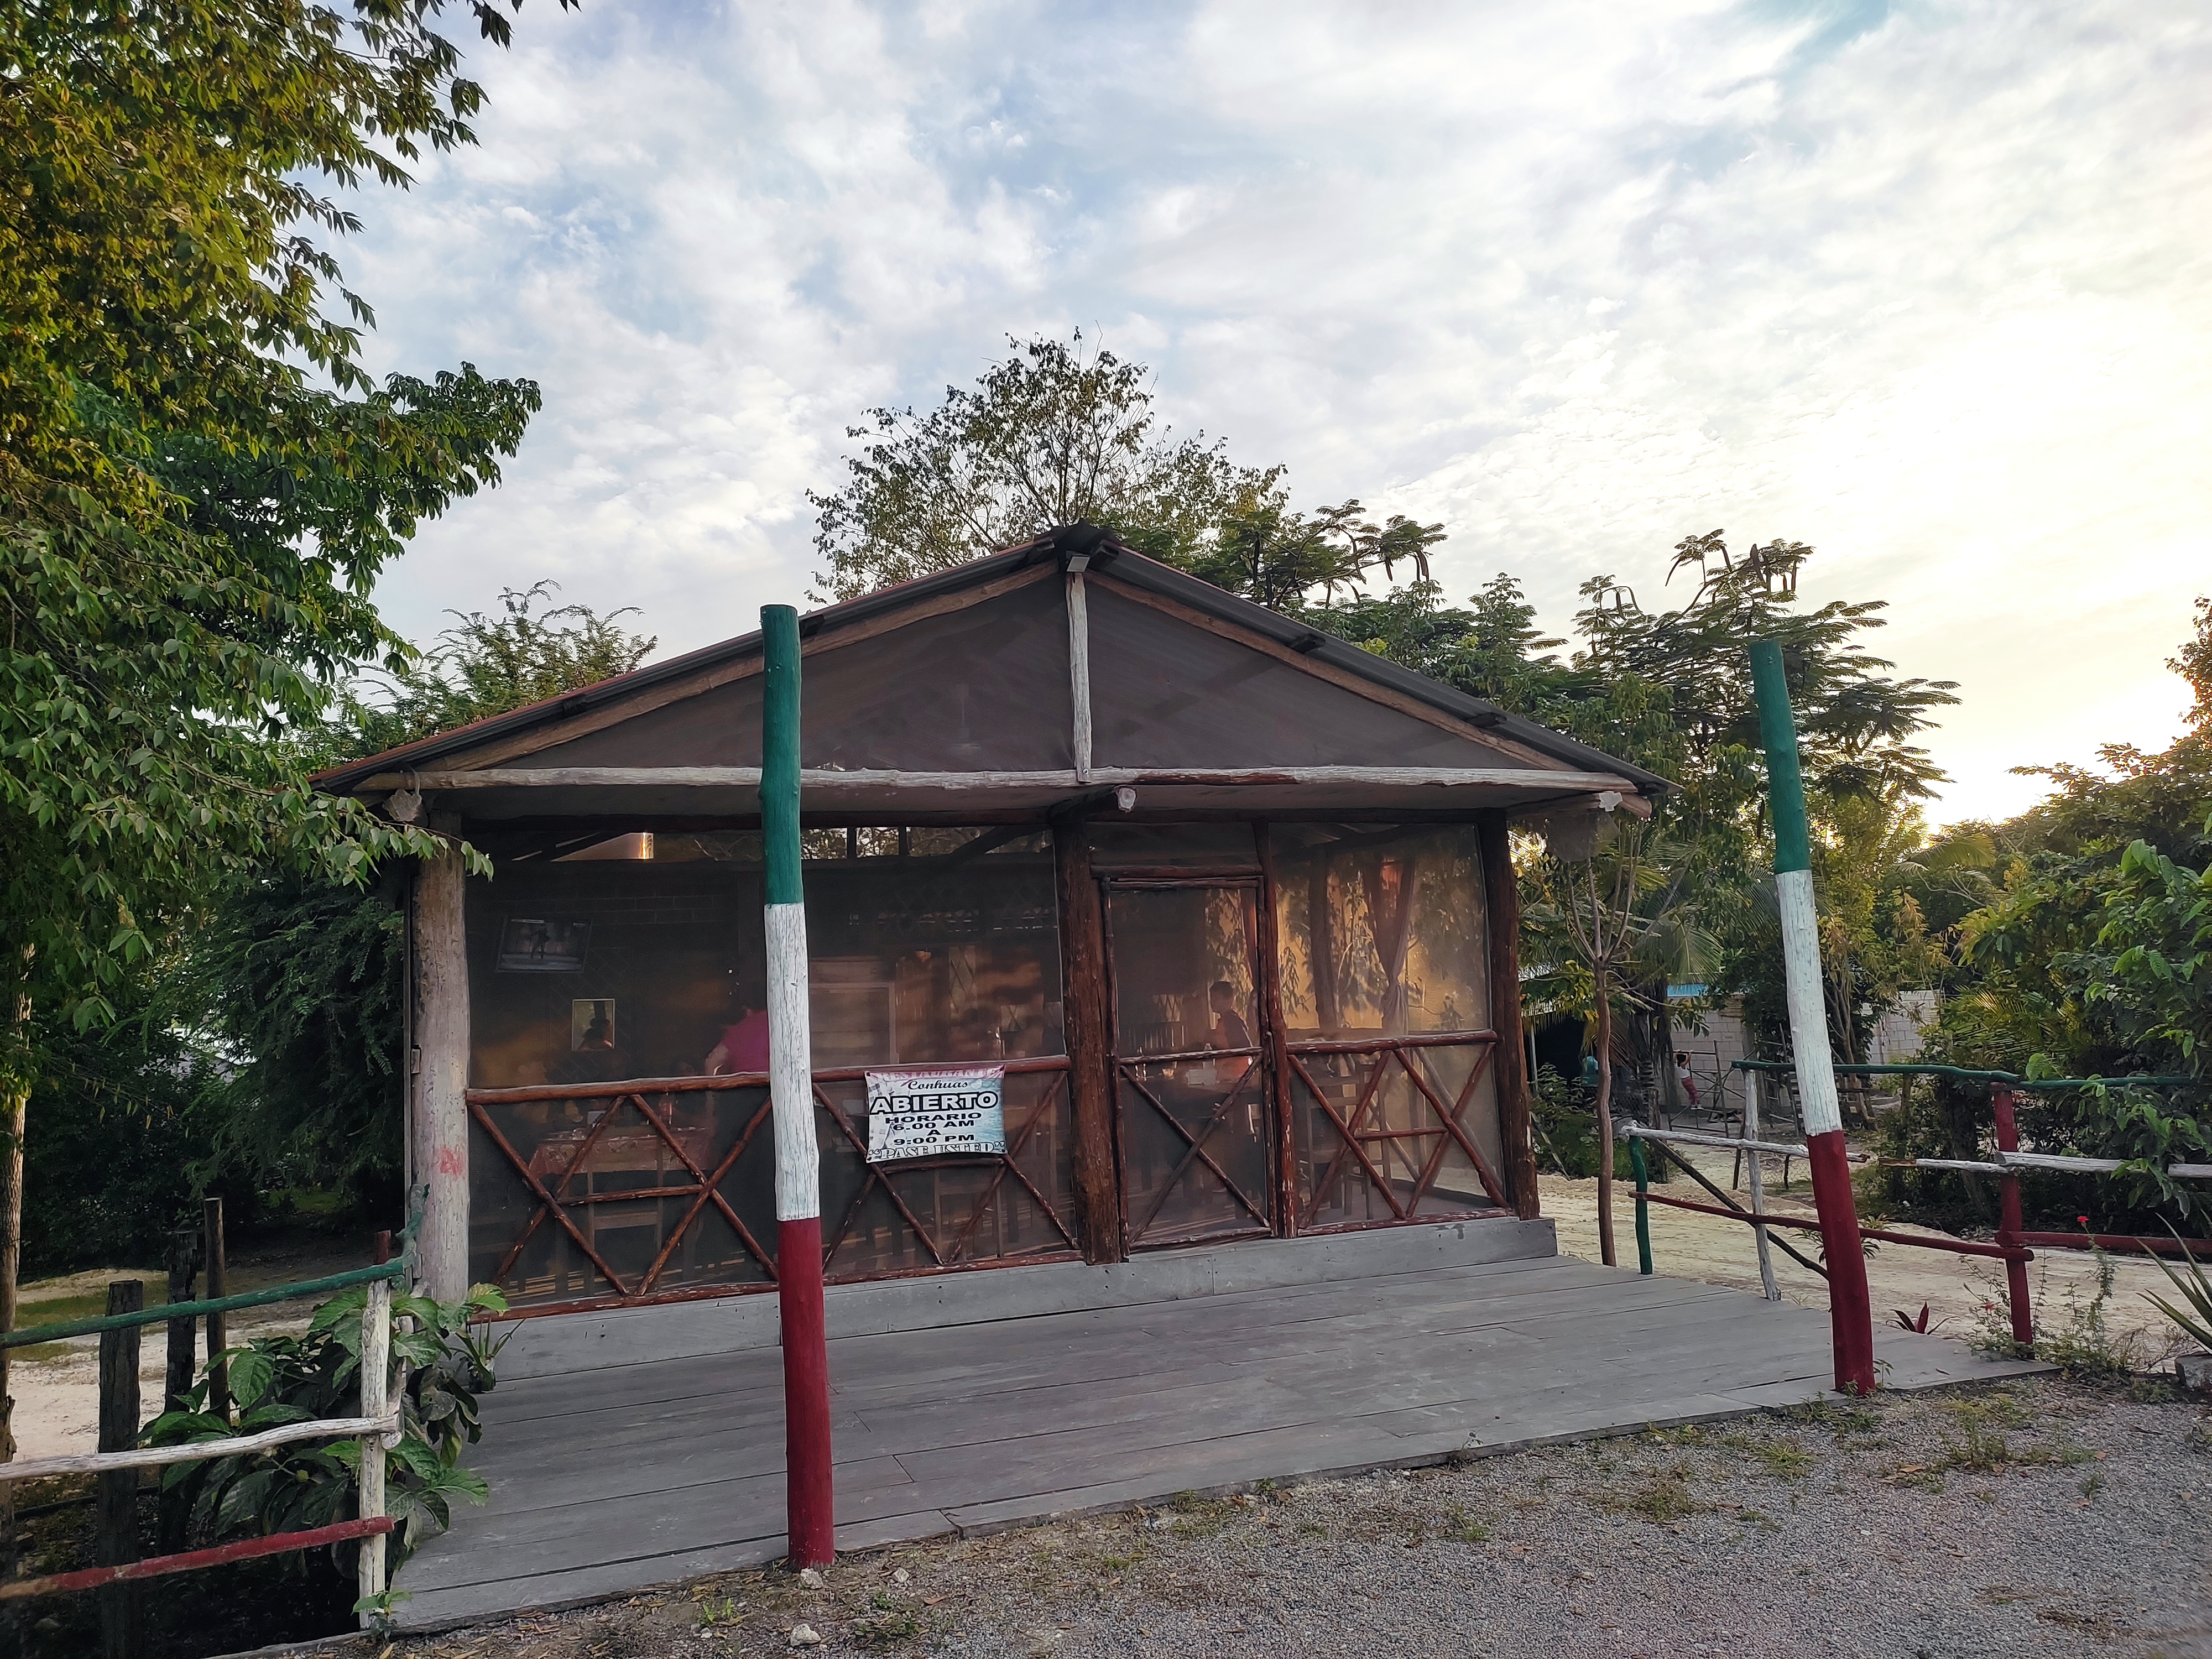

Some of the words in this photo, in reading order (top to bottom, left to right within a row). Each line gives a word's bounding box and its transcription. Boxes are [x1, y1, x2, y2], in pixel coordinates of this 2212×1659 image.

[907, 1079, 968, 1090] Conhuas
[870, 1091, 998, 1115] ABIERTO
[885, 1112, 982, 1124] HORARIO
[943, 1120, 974, 1128] AM
[893, 1137, 937, 1145] 9:00
